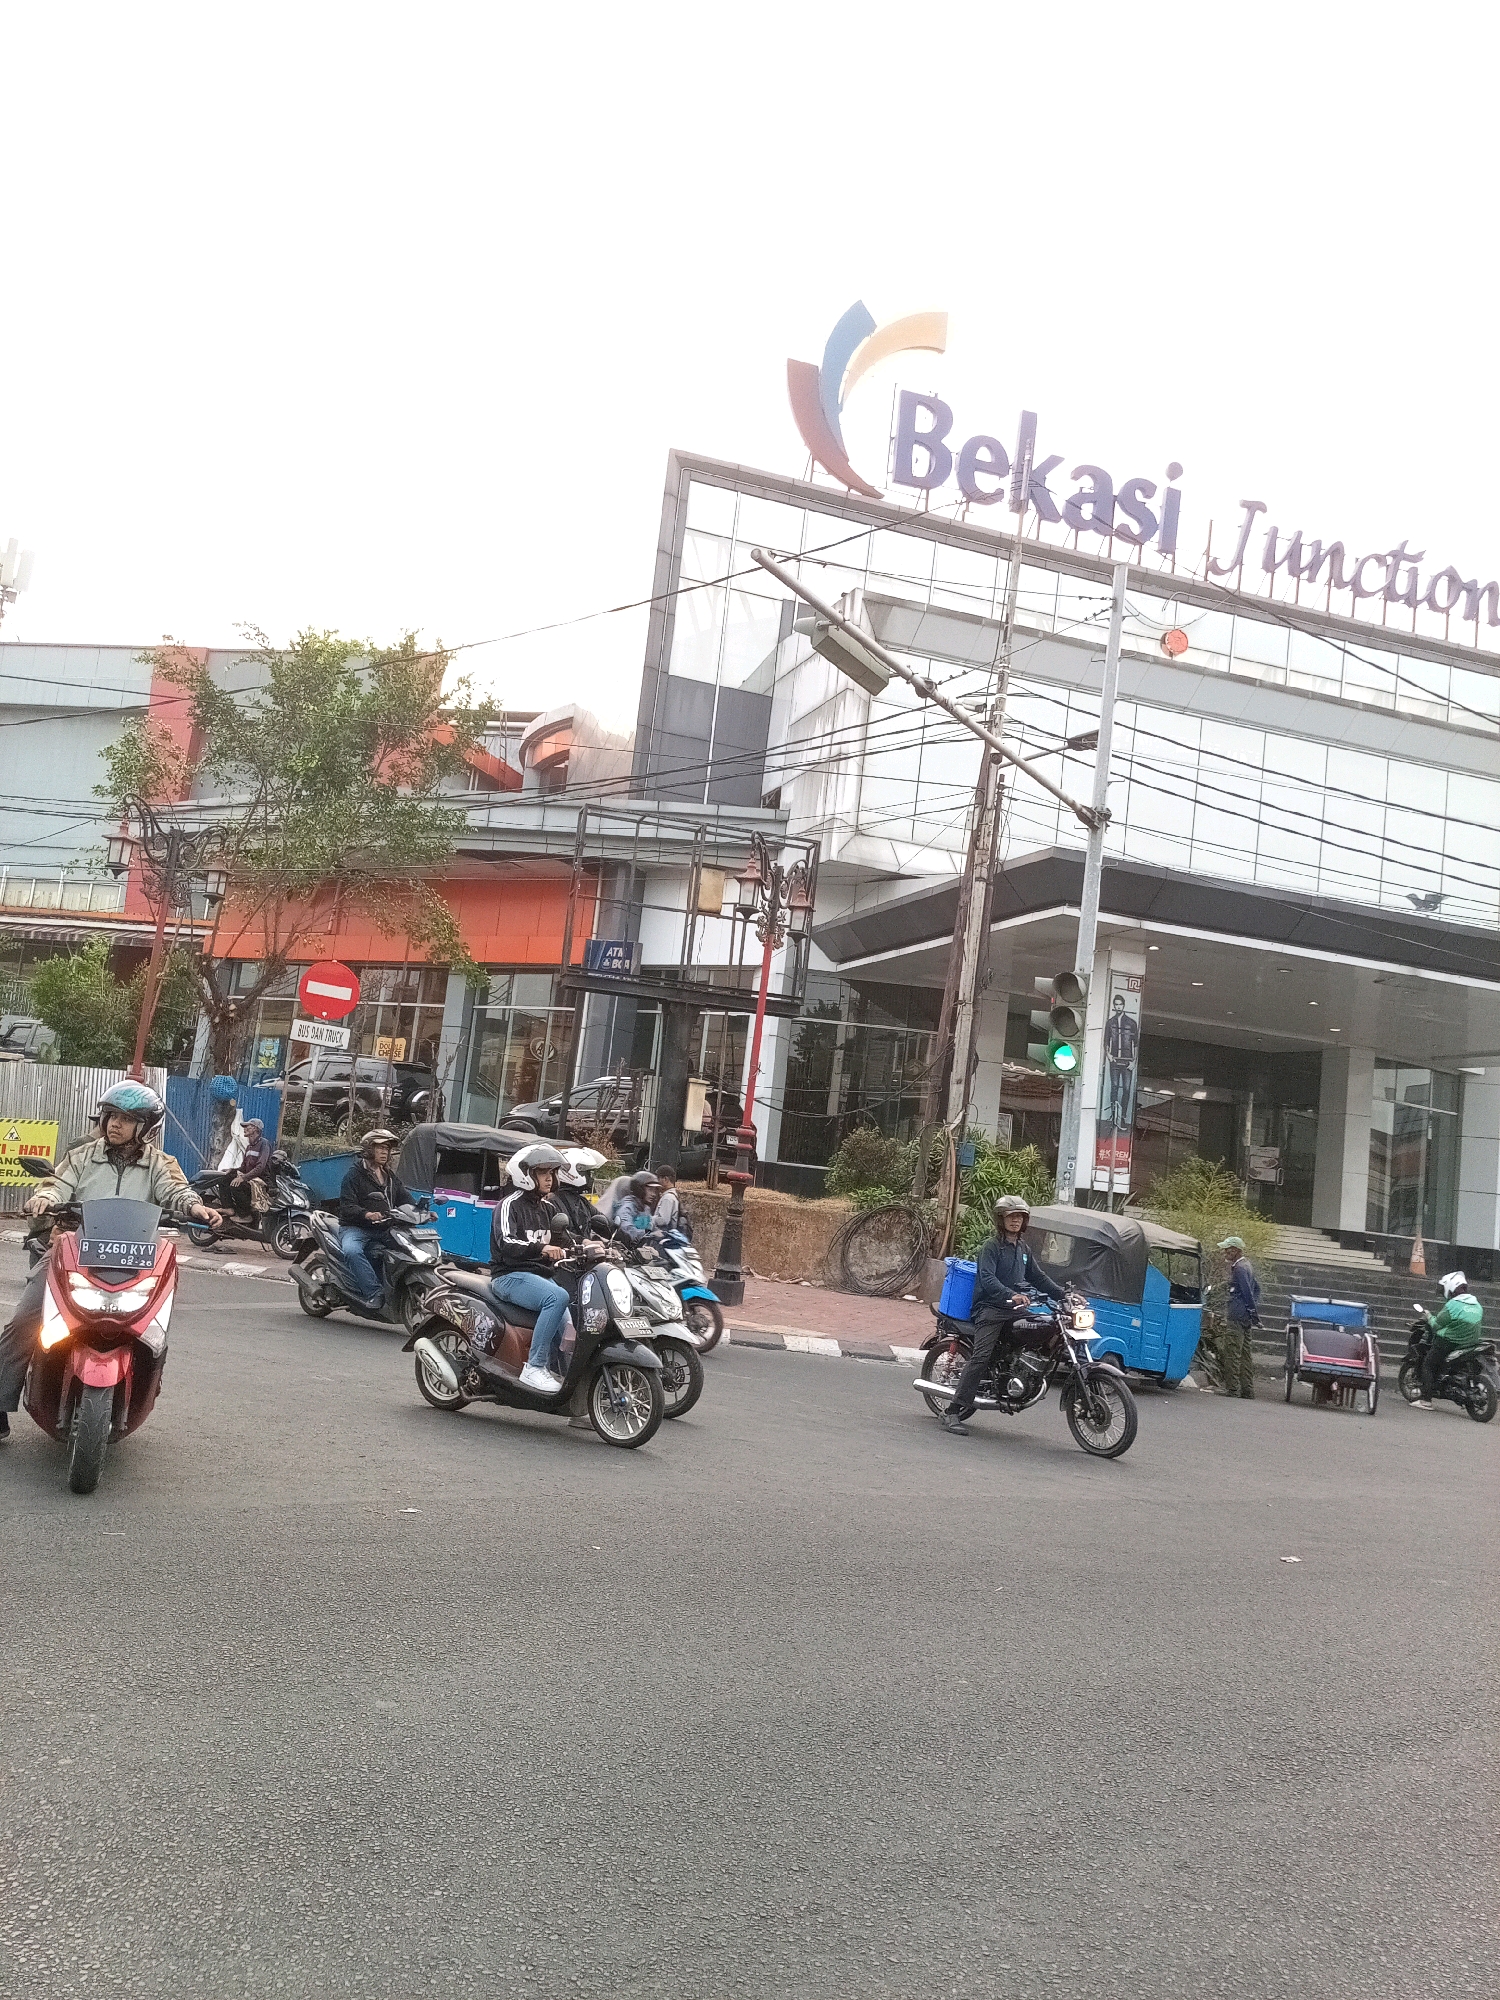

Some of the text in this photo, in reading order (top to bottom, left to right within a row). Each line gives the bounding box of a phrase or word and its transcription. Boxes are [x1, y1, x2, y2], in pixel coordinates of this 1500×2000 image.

[892, 389, 1500, 628] Bekasi Junction
[297, 1023, 345, 1044] BUS DAN TRUCK
[18, 1144, 51, 1157] HATI
[81, 1241, 155, 1256] B 3460 KYV
